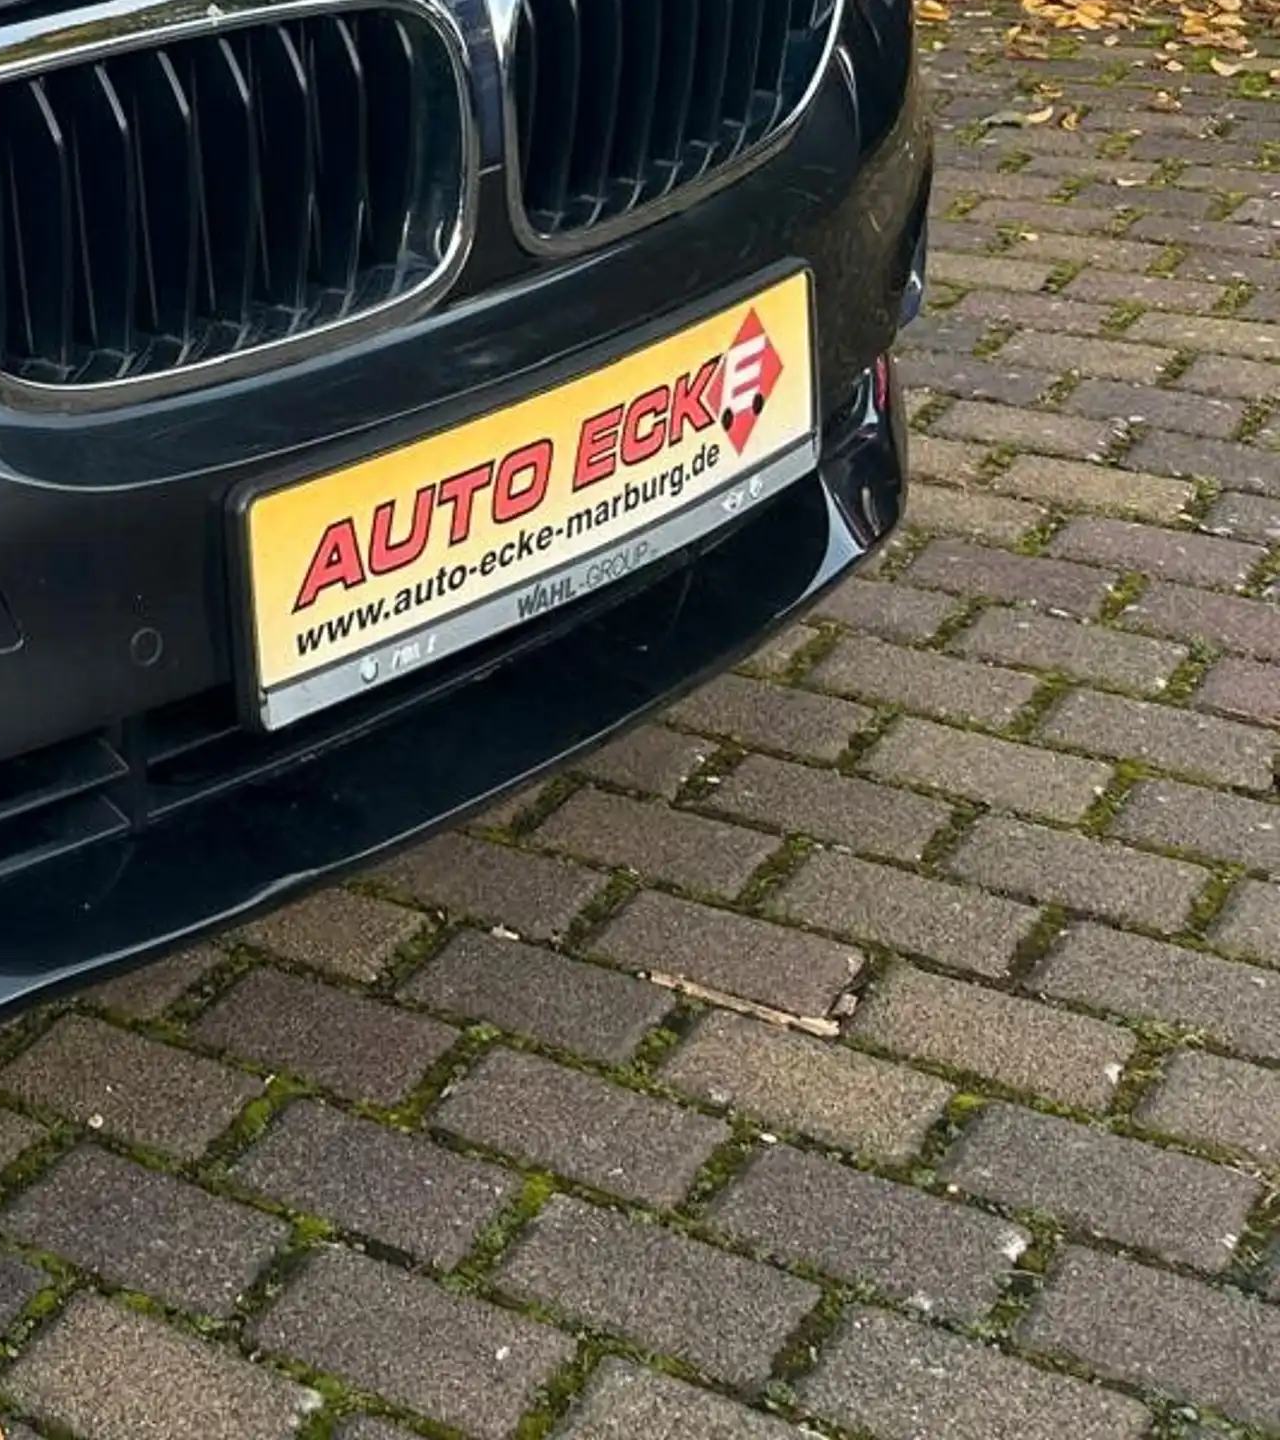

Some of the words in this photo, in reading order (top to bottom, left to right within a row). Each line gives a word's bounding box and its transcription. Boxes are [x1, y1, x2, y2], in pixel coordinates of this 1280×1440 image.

[291, 439, 554, 615] AUTO
[571, 333, 767, 490] ECKE
[296, 441, 721, 657] www.auto-ecke-marburg.de
